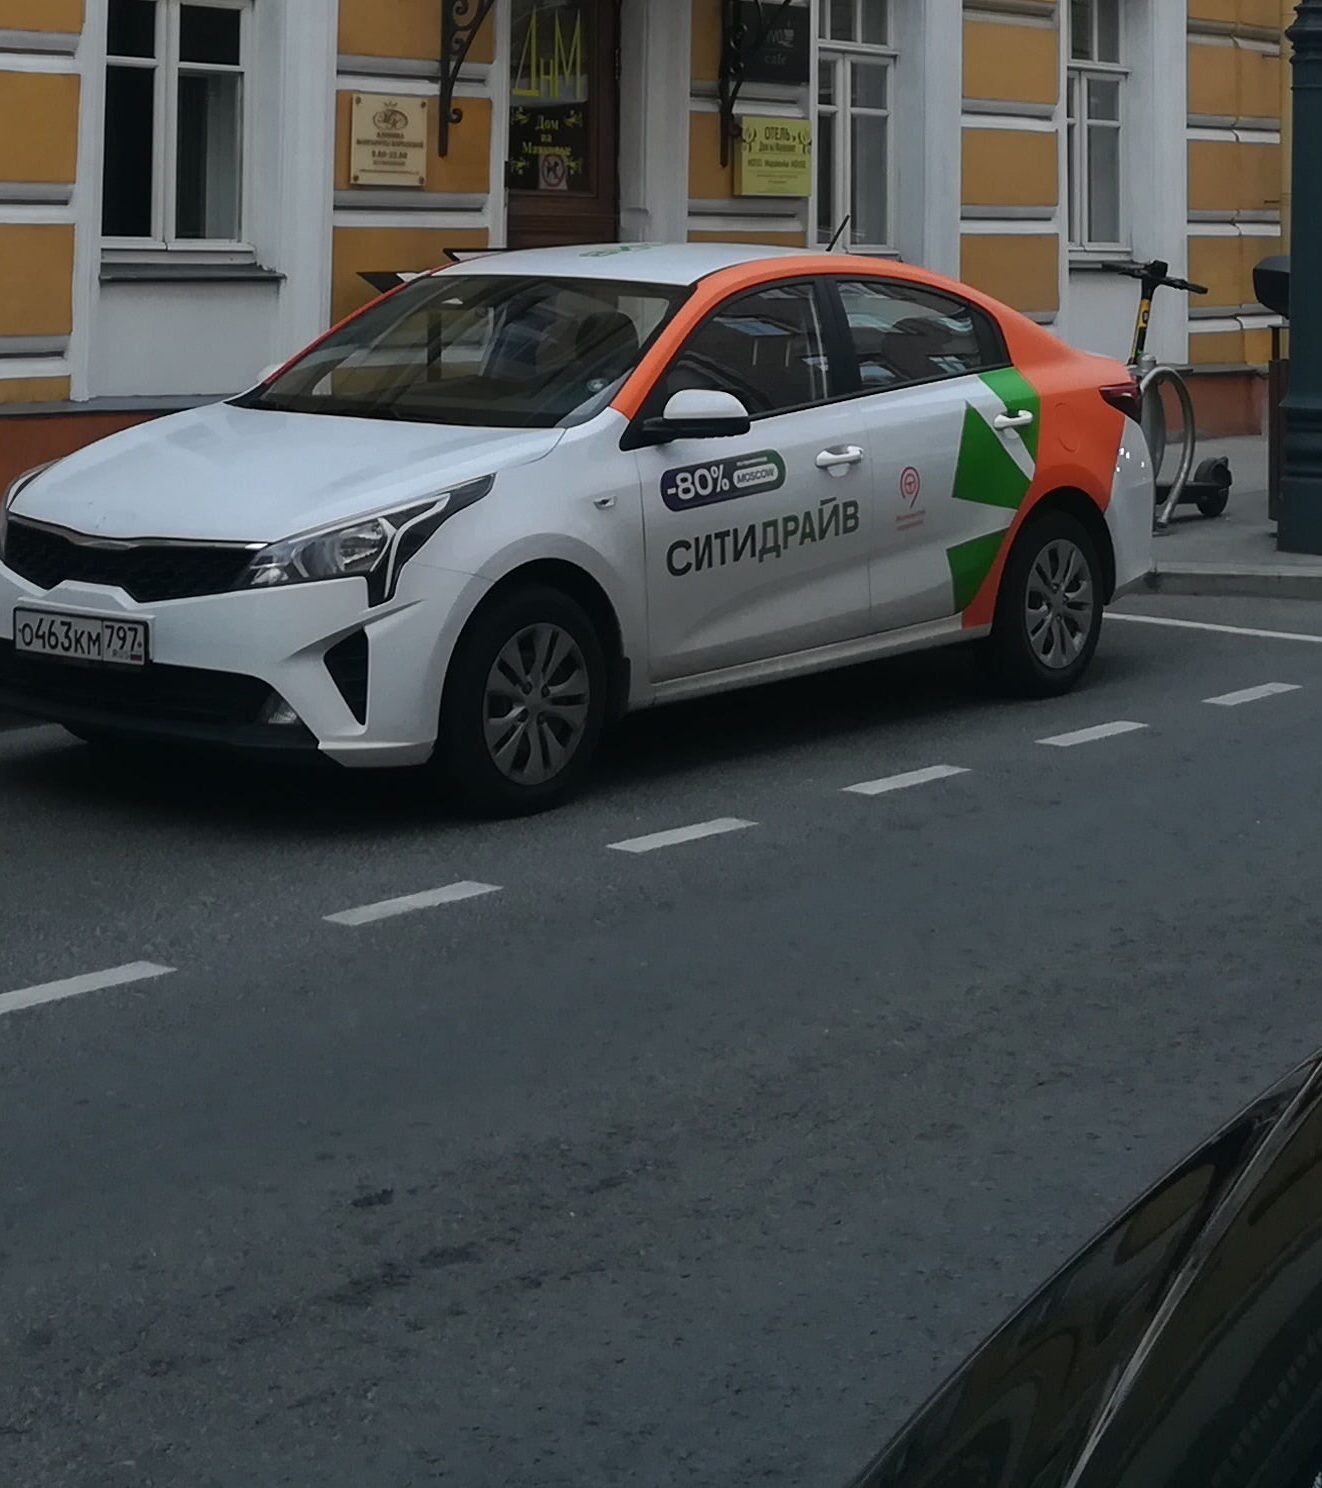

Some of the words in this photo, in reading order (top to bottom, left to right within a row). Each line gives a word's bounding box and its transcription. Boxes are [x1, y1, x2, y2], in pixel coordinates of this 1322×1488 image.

[666, 463, 731, 501] -80%
[736, 467, 775, 486] MOSCOW
[665, 496, 861, 578] СИТИДРАЙВ
